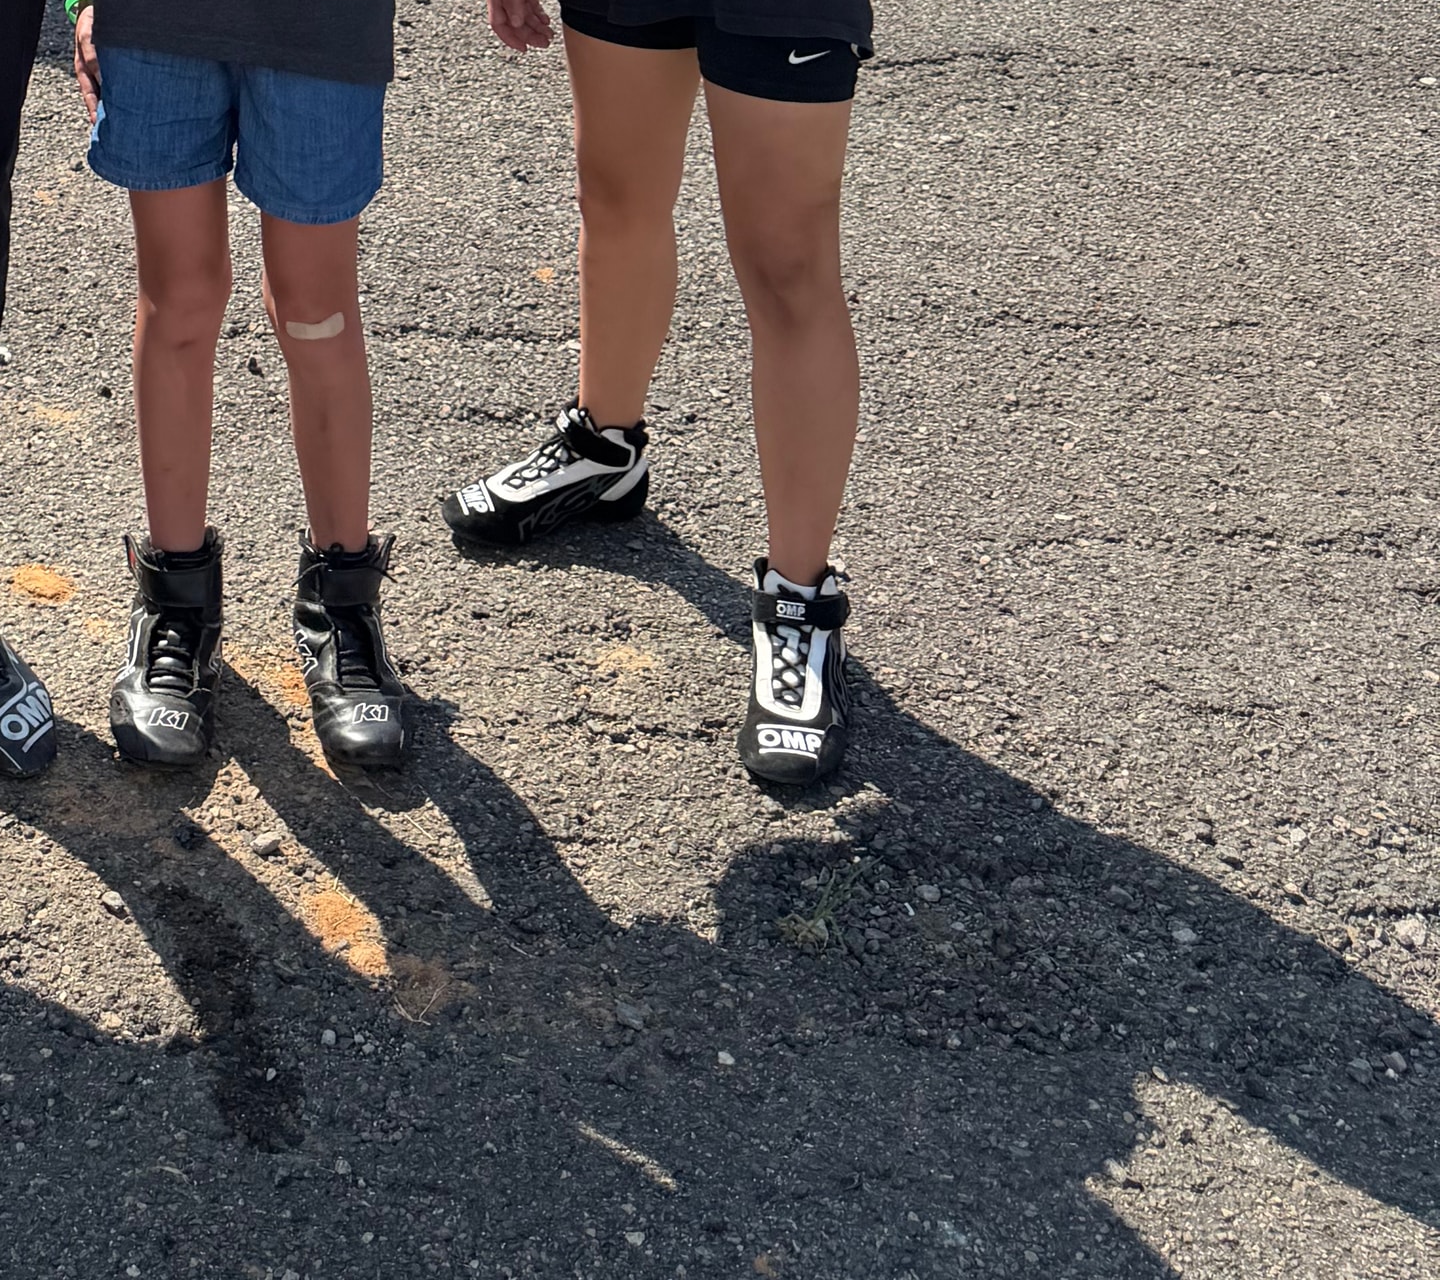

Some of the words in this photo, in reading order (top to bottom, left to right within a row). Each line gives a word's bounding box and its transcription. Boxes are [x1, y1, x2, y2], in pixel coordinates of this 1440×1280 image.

[462, 484, 488, 513] OMP
[776, 603, 806, 616] OMP
[0, 688, 53, 740] OMP
[148, 706, 189, 730] K1
[352, 702, 389, 724] K1
[757, 728, 822, 752] OMP
